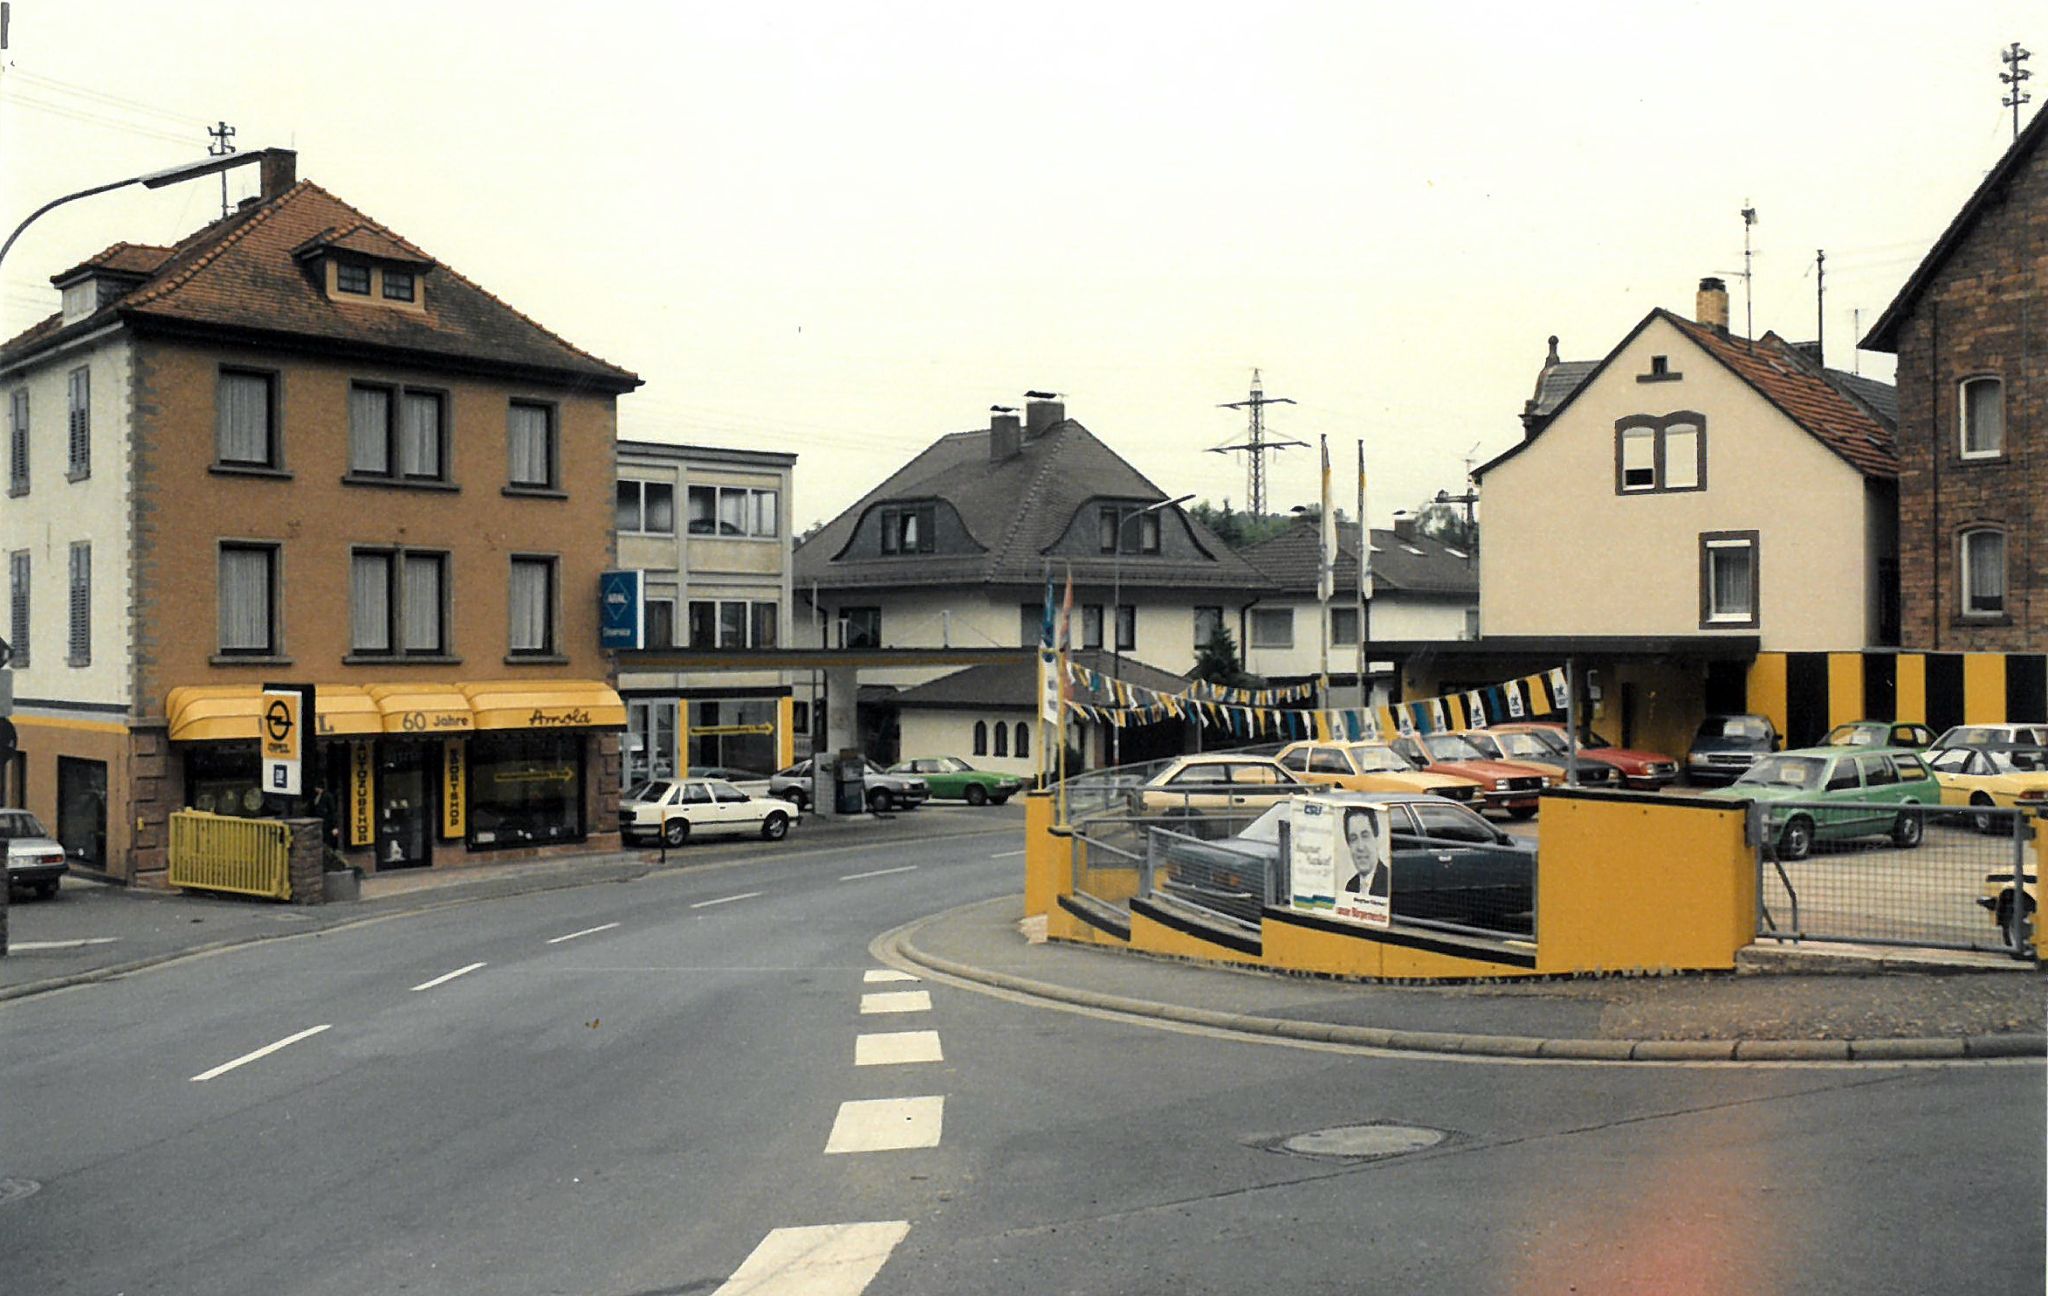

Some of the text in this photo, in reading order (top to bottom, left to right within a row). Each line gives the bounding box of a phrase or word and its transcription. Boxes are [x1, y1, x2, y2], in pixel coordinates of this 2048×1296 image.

[402, 711, 469, 731] 60 Jahre
[529, 709, 592, 726] Arnold
[1304, 805, 1322, 815] CSU
